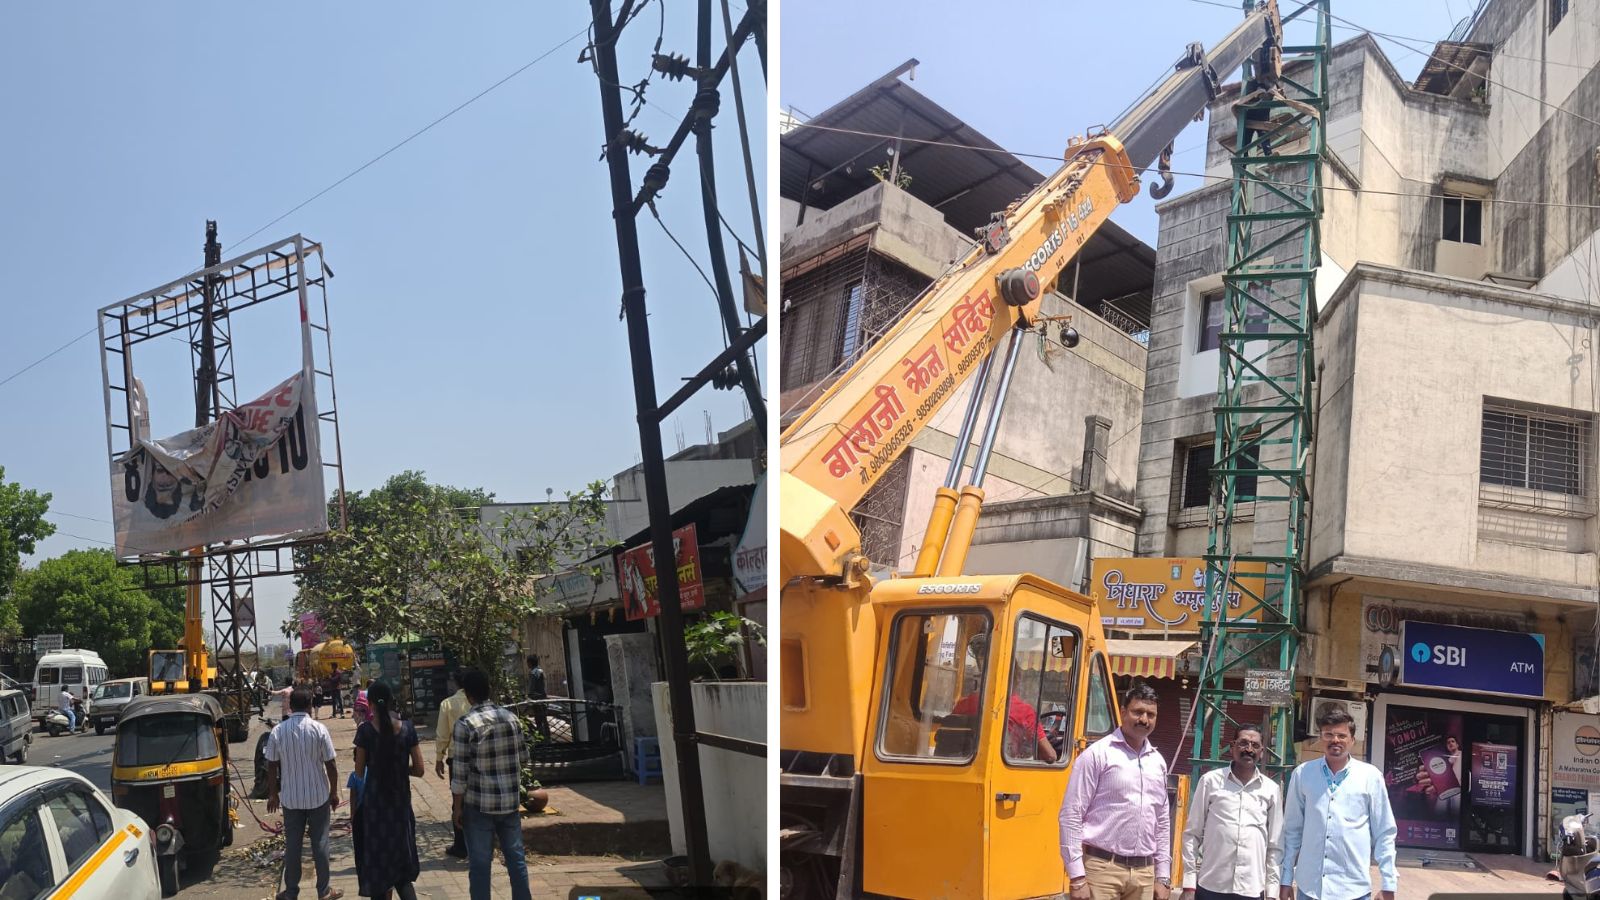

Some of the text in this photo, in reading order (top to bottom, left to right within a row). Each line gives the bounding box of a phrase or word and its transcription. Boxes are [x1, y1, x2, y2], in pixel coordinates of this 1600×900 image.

[1021, 228, 1064, 272] SCORTS
[821, 383, 906, 479] बालाजी
[902, 343, 946, 395] क्रेन
[917, 584, 982, 594] ESCORTS
[1103, 569, 1188, 625] त्रिधारा
[1433, 644, 1466, 667] SBI
[1509, 661, 1535, 674] ATM
[1573, 756, 1593, 765] Indian
